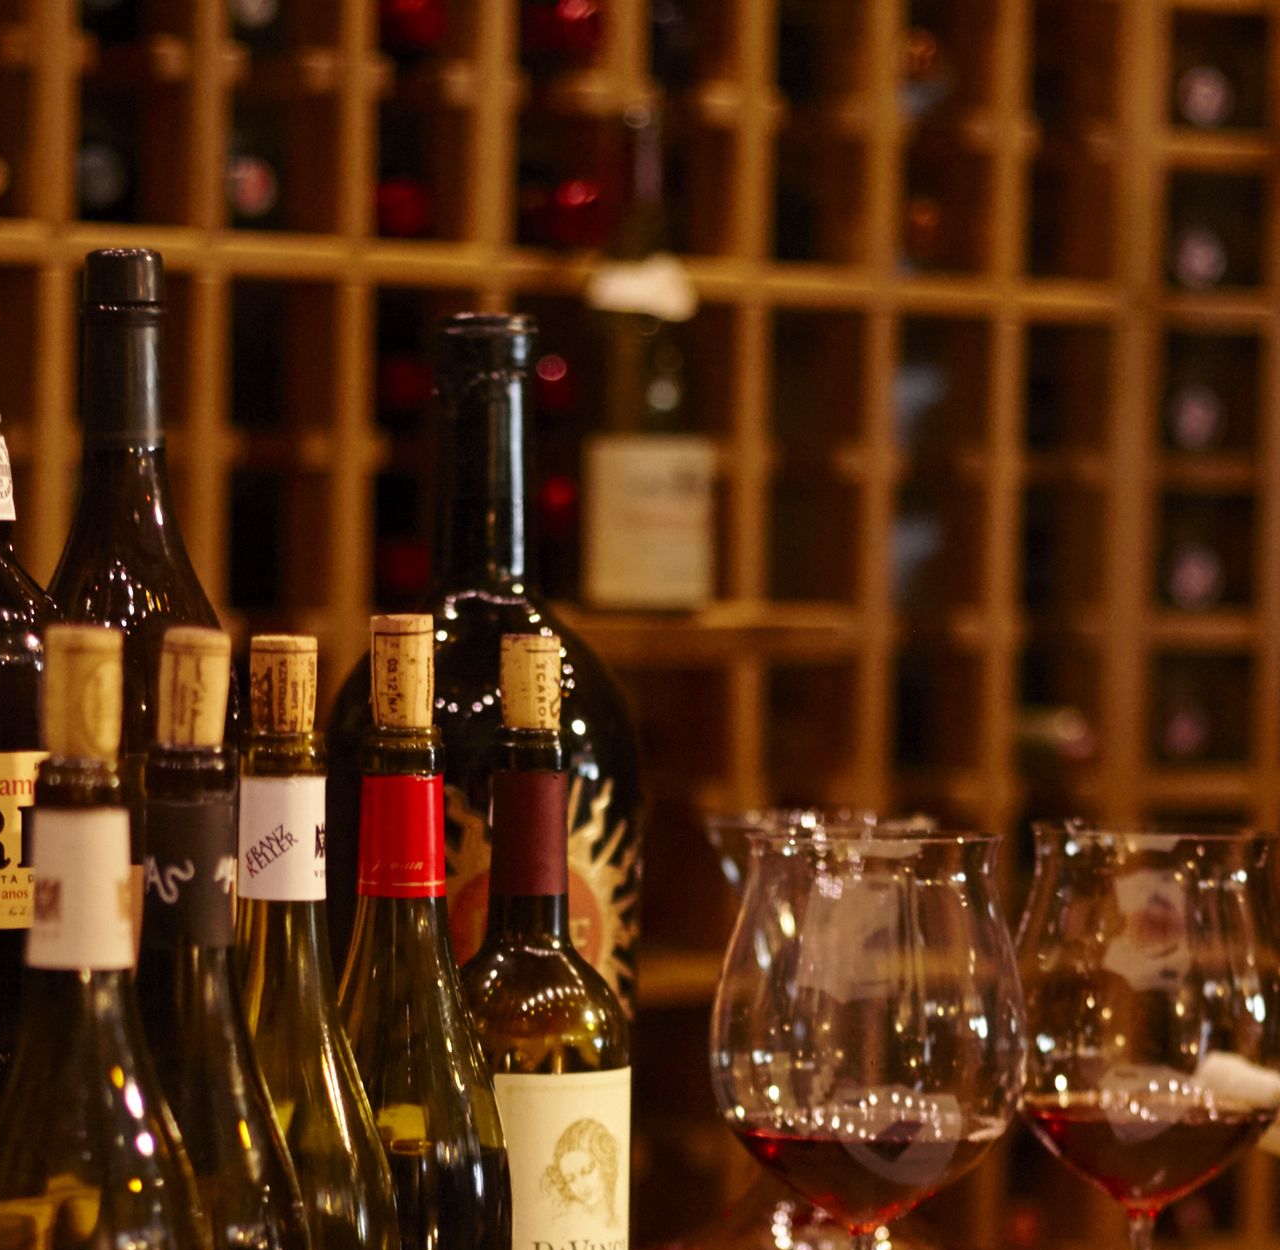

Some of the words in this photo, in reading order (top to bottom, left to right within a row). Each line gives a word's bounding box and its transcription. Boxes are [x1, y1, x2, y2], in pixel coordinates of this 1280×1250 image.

[245, 823, 287, 867] FRANZ
[246, 831, 299, 878] KELLER
[2, 889, 29, 900] anos
